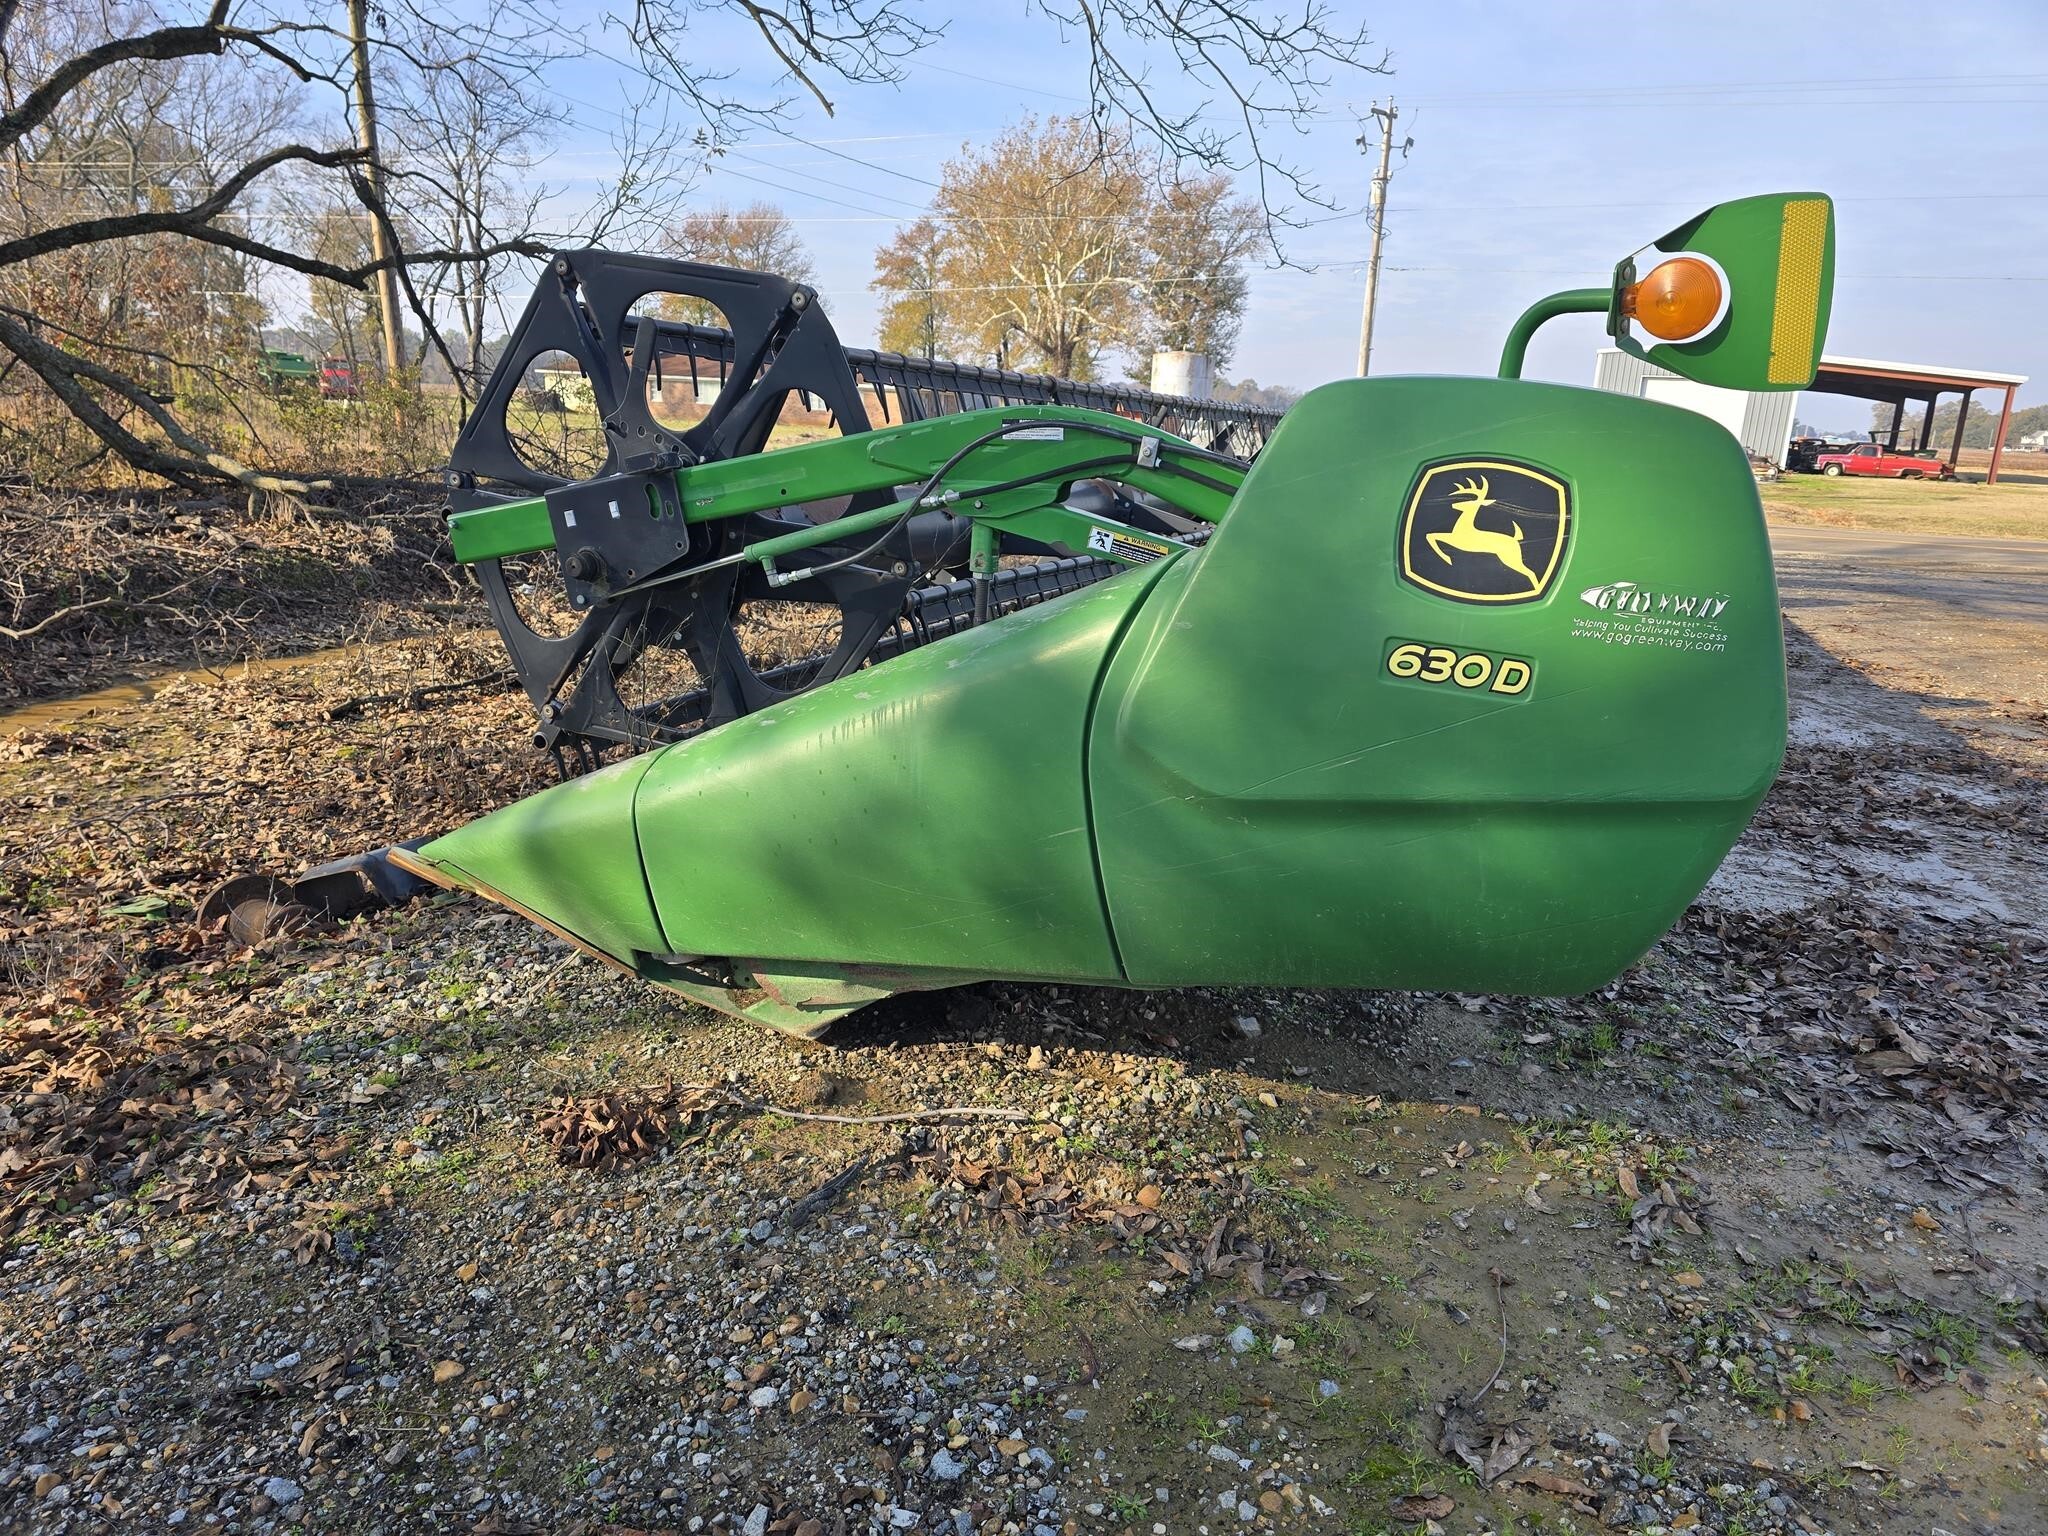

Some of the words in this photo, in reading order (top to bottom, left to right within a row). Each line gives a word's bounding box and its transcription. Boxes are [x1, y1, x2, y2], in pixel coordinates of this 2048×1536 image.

[1131, 537, 1161, 551] WARNING
[1613, 622, 1631, 632] You
[1634, 623, 1680, 637] Cultivate
[1683, 629, 1728, 642] Success
[1386, 643, 1533, 695] 630D
